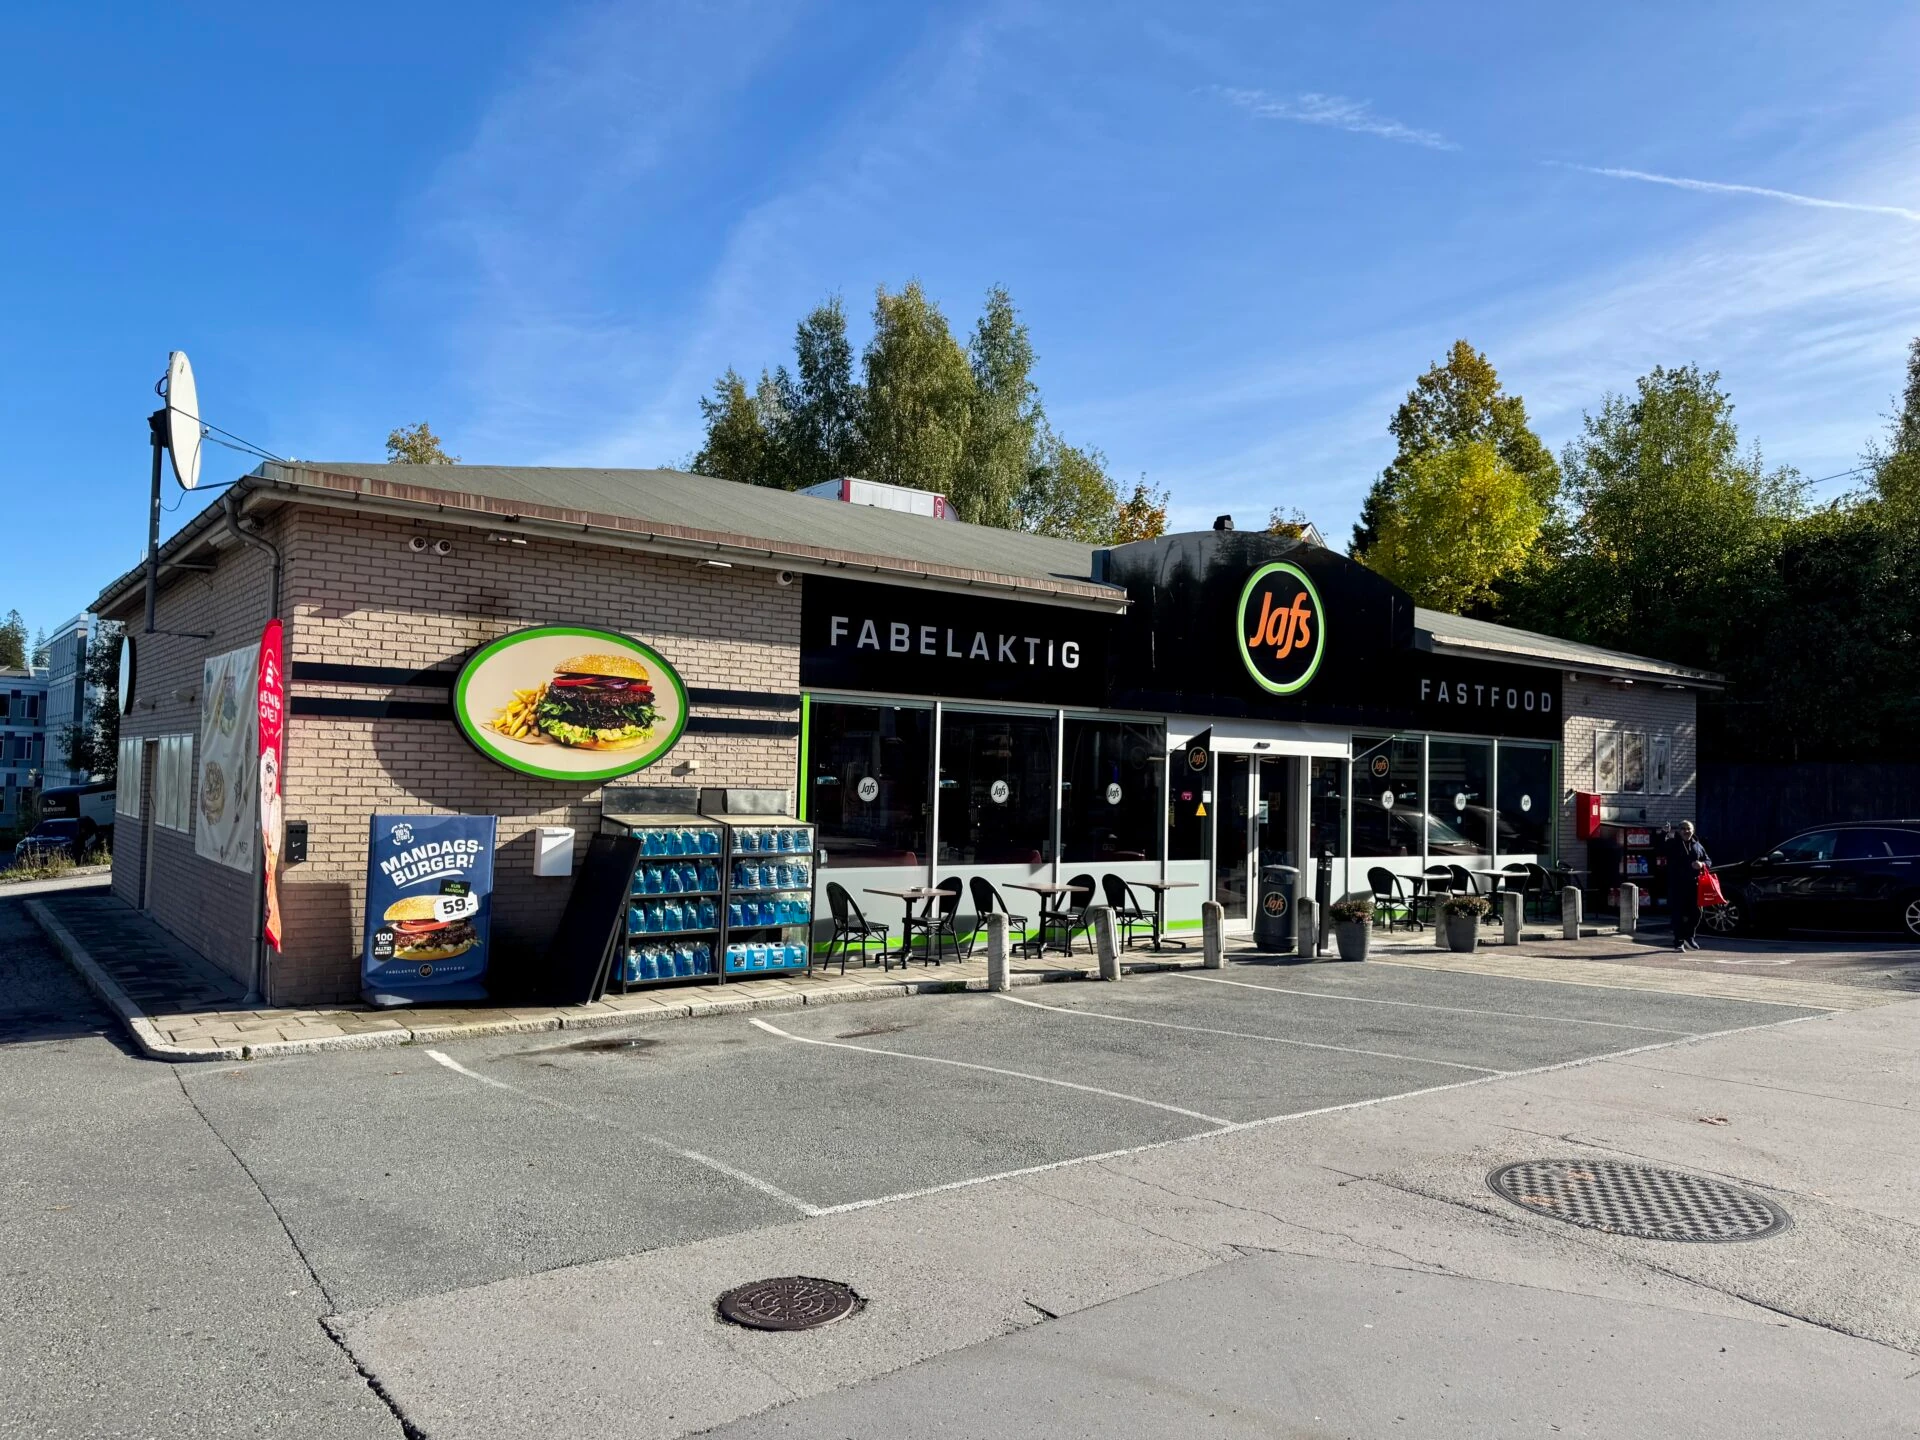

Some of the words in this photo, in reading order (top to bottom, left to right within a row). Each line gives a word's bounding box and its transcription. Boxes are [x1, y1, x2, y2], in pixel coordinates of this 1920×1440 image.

[1248, 591, 1312, 660] Jafs
[830, 615, 1080, 669] FABELAKTIG
[1421, 678, 1552, 713] FASTFOOD
[861, 781, 877, 798] Jafs
[993, 784, 1008, 799] Jafs
[1107, 786, 1121, 800] Jafs
[380, 839, 484, 875] MANDAGS-
[390, 854, 475, 887] BURGER!
[442, 897, 474, 915] 59,-
[1263, 895, 1285, 914] Jafs
[375, 932, 394, 942] 100
